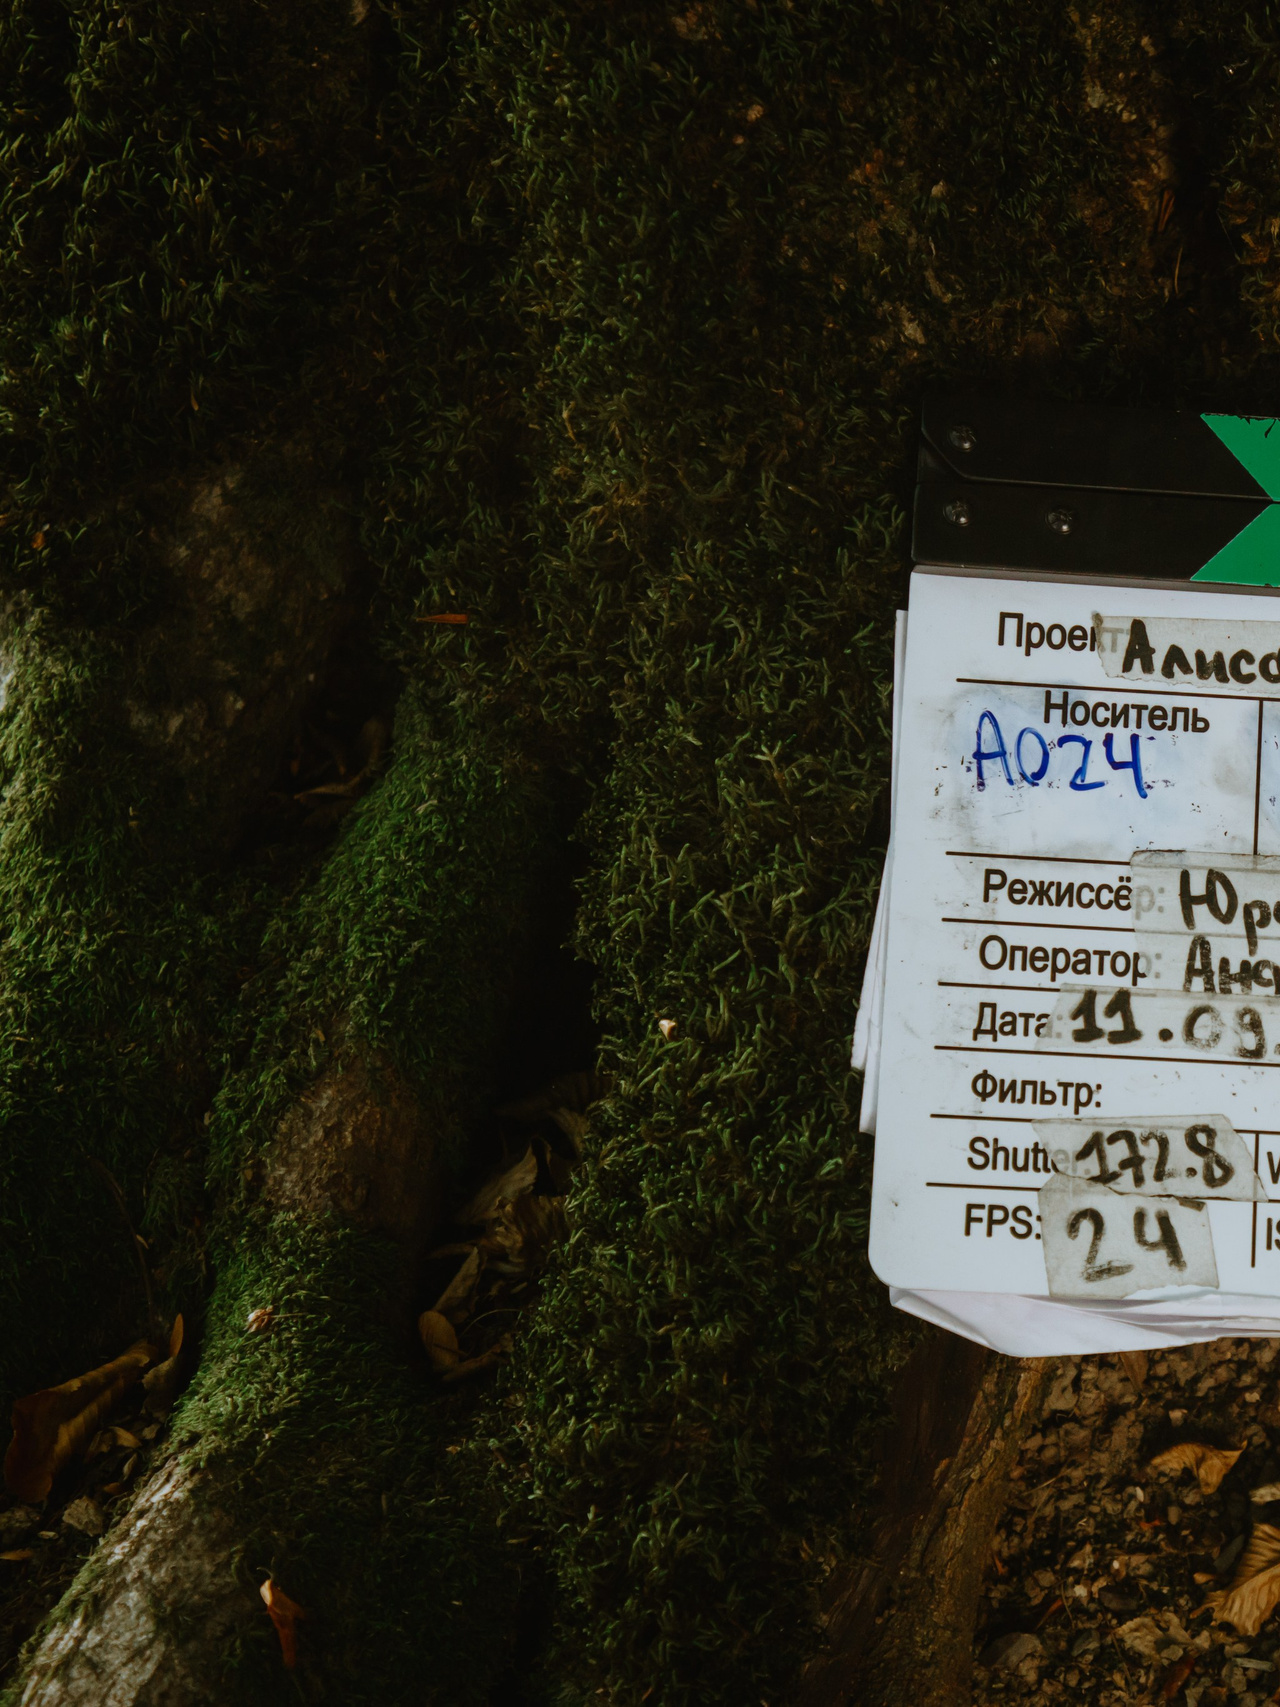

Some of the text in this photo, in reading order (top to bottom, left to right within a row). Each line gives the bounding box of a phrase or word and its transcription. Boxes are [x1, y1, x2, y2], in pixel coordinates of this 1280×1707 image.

[1044, 690, 1210, 733] Носитель
[971, 1069, 1102, 1114] Фильтр:
[1075, 1124, 1234, 1189] 172.8
[964, 1204, 1041, 1241] FPS:
[1066, 1206, 1187, 1282] 24
